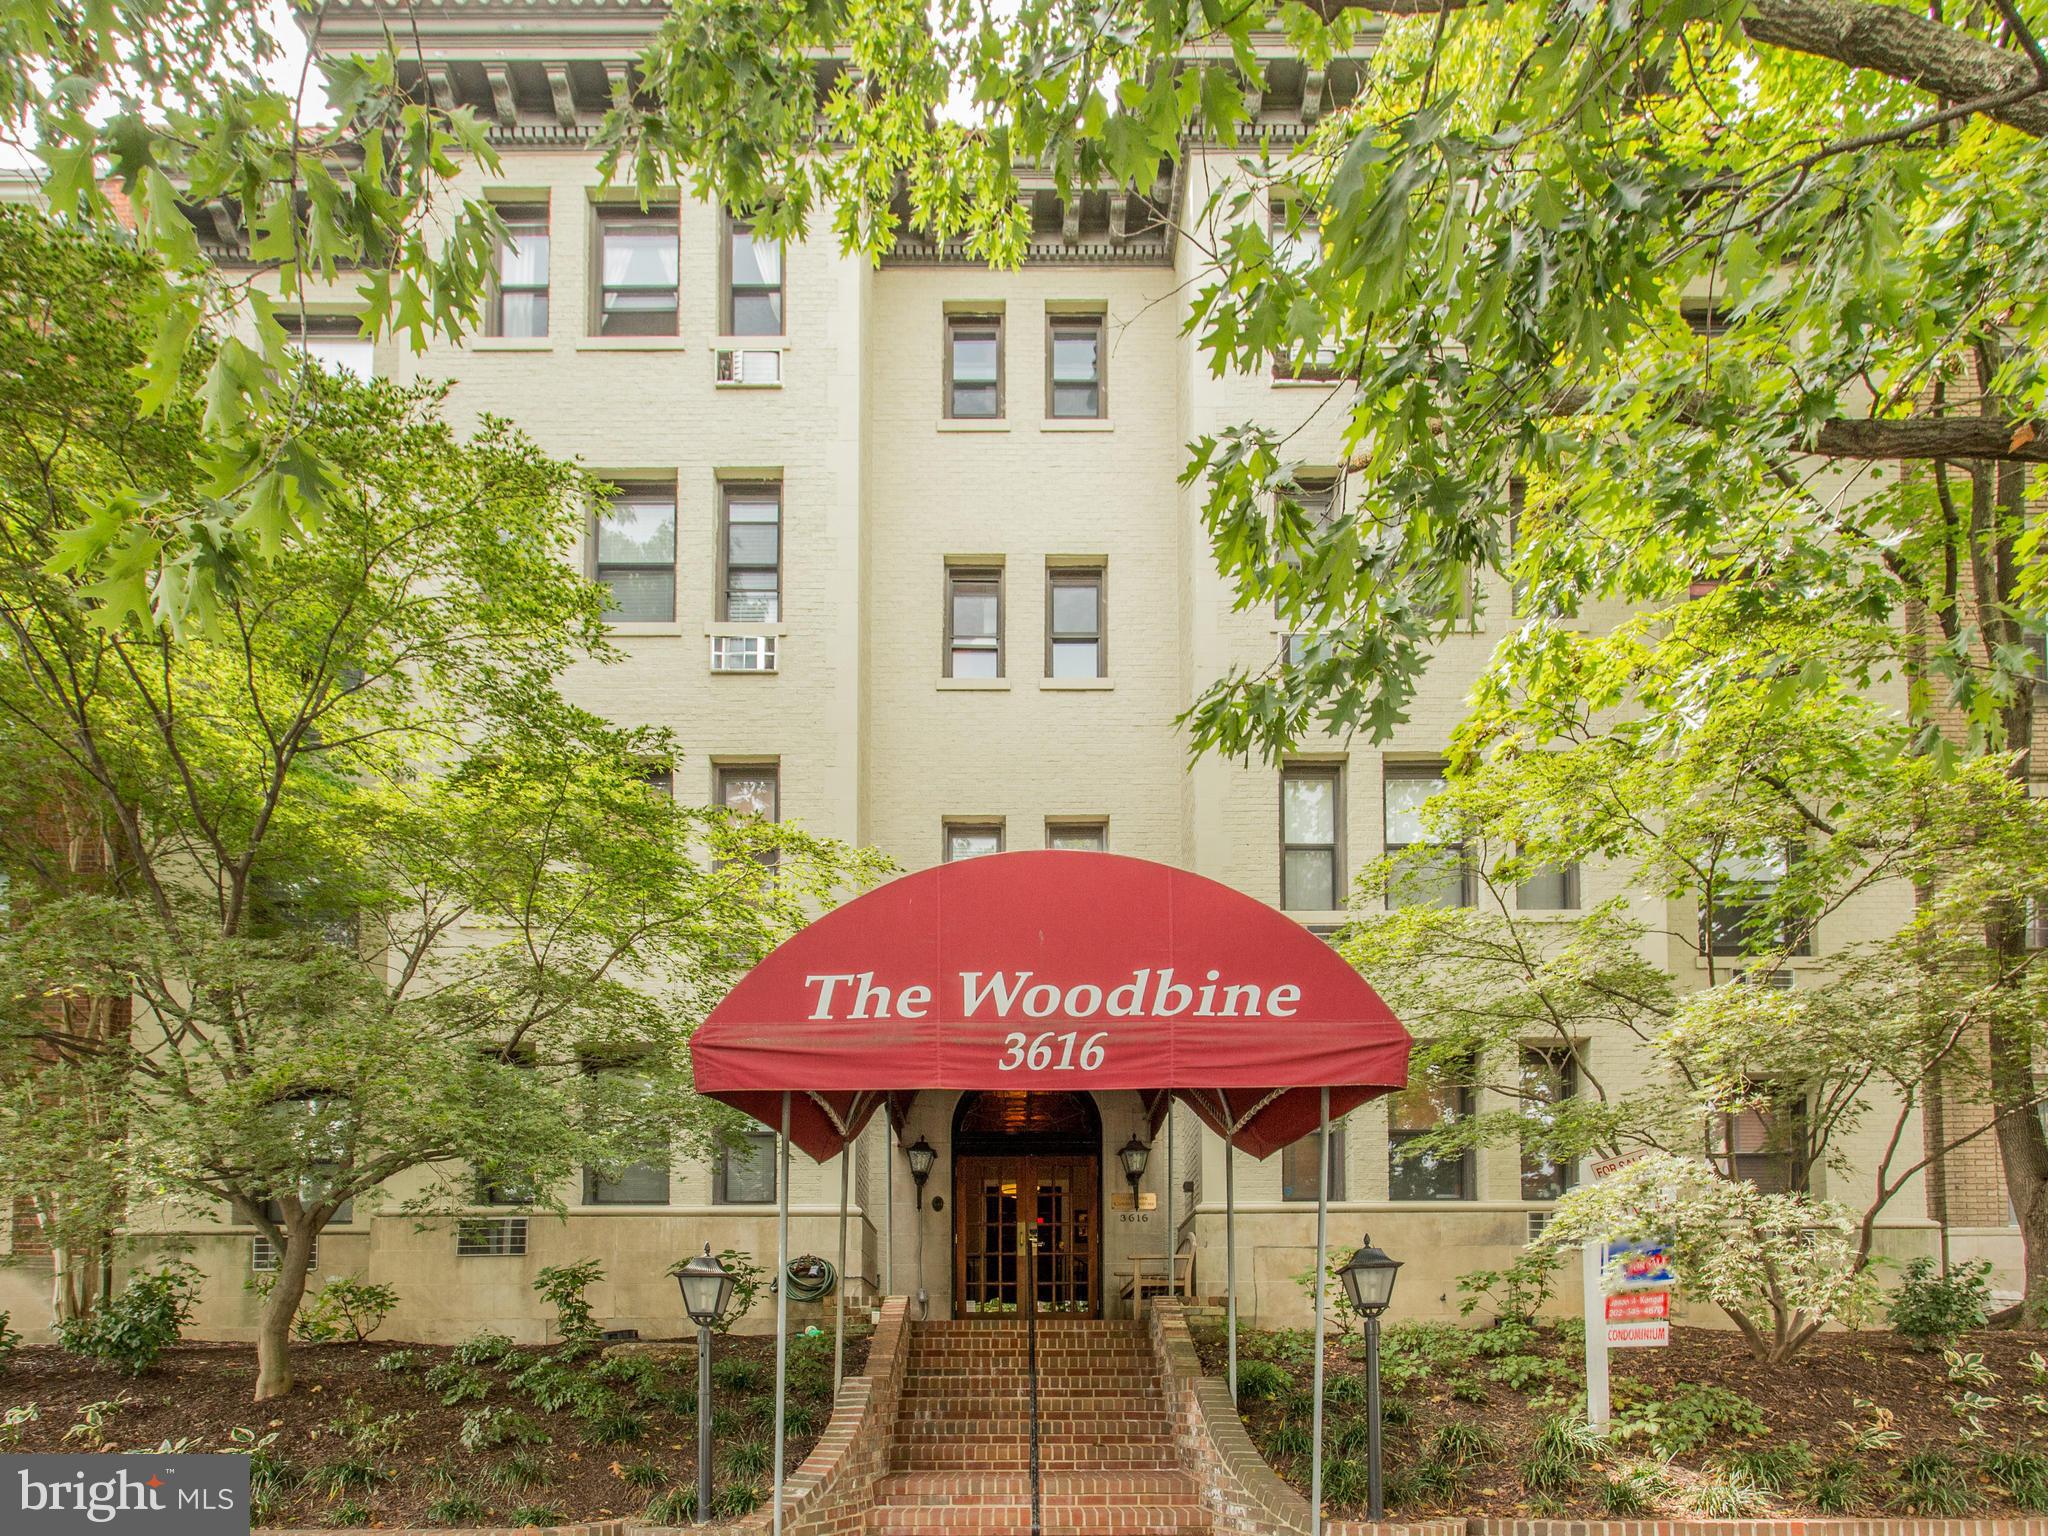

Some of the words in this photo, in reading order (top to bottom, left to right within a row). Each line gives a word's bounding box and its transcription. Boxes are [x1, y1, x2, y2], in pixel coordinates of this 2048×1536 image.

[804, 971, 932, 1020] The
[958, 967, 1301, 1018] Woodbine
[998, 1031, 1109, 1071] 3616
[1119, 1214, 1149, 1223] 3616
[1607, 1327, 1665, 1342] CONDOMINIUM
